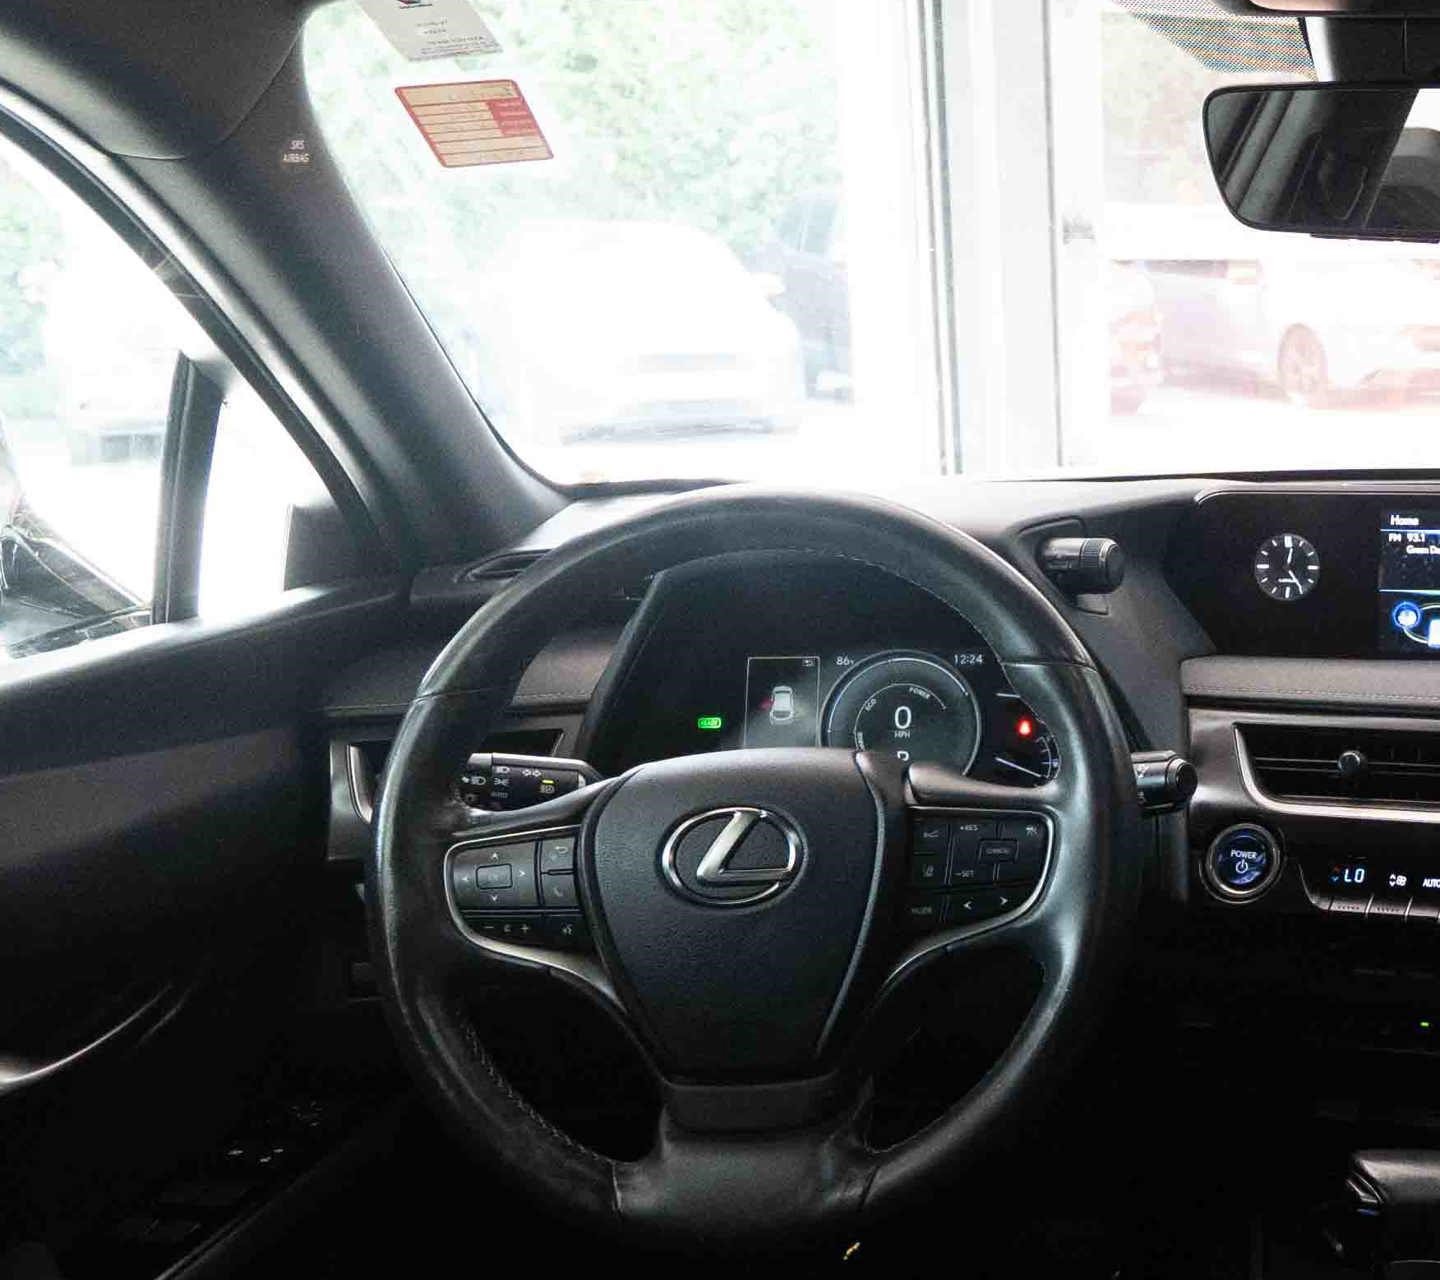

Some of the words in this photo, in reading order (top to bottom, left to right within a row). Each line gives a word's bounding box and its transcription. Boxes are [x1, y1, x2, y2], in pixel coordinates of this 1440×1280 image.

[1390, 514, 1419, 526] Home
[1388, 533, 1402, 542] FM
[1407, 533, 1425, 543] 93.1
[954, 654, 984, 665] 12:24
[894, 706, 912, 729] 0
[894, 731, 911, 739] MPH
[1230, 849, 1257, 860] POWER
[1344, 868, 1365, 883] LO
